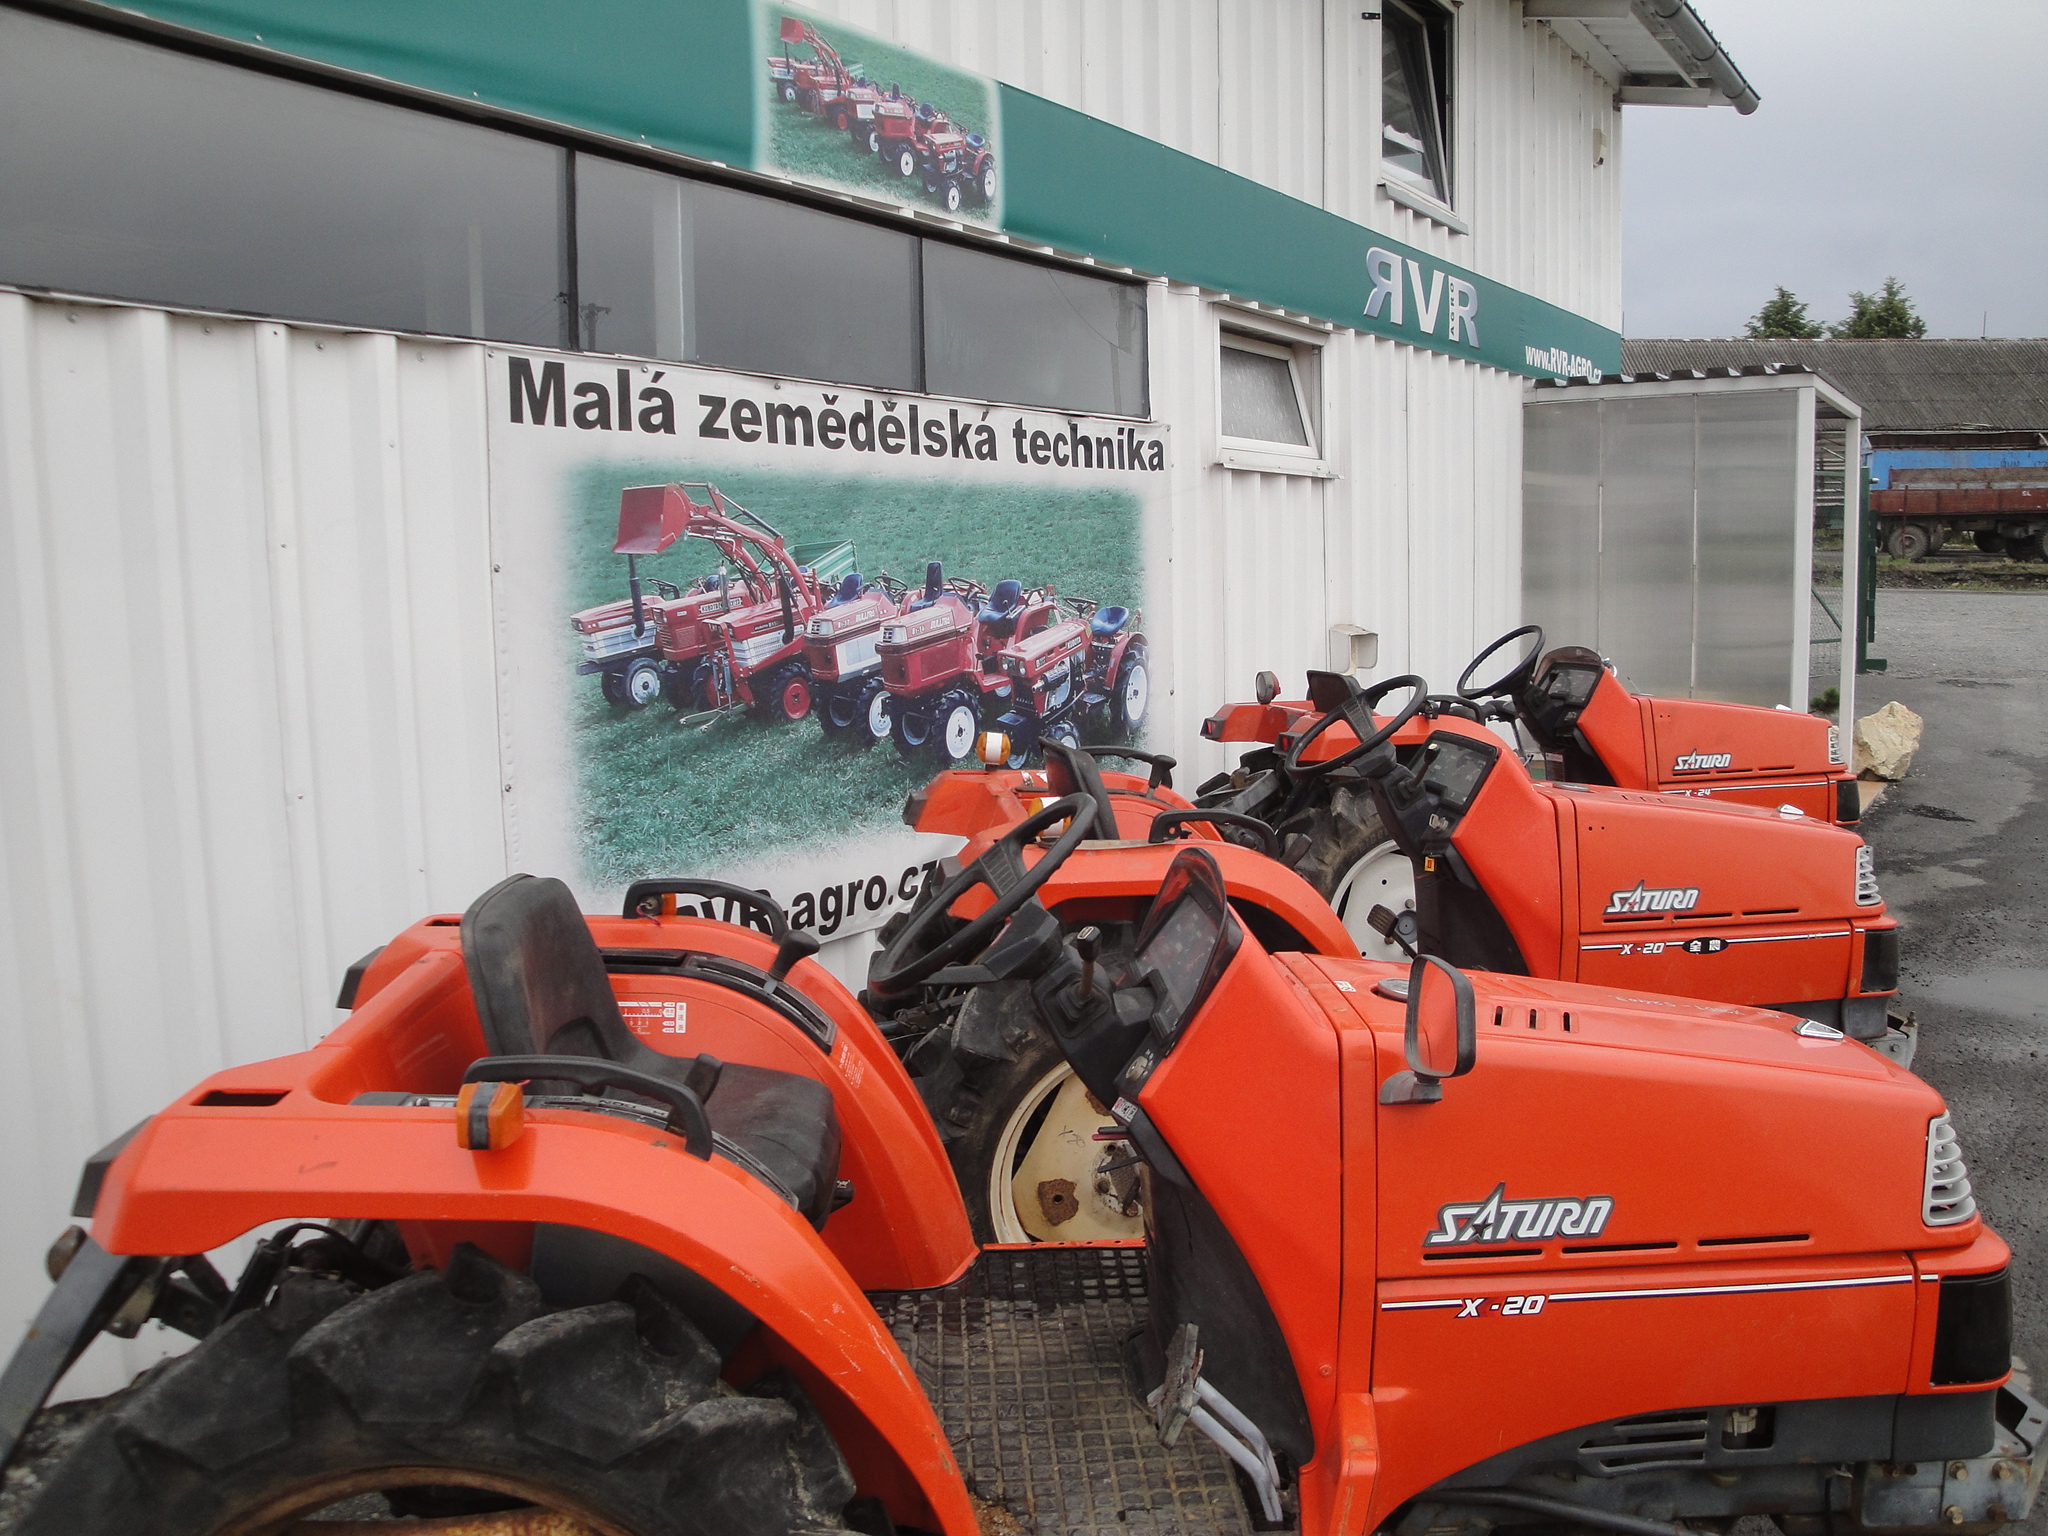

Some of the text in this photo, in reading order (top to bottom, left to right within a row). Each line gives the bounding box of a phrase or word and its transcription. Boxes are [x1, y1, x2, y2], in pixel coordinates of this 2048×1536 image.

[508, 356, 1165, 471] Malá zemědělská technika
[1672, 748, 1732, 771] SATURN
[677, 860, 938, 936] VR-agro.cz
[1603, 880, 1700, 915] SATURN
[1619, 942, 1665, 955] X-20
[1424, 1182, 1614, 1247] SATURN
[1455, 1295, 1545, 1319] X-20
